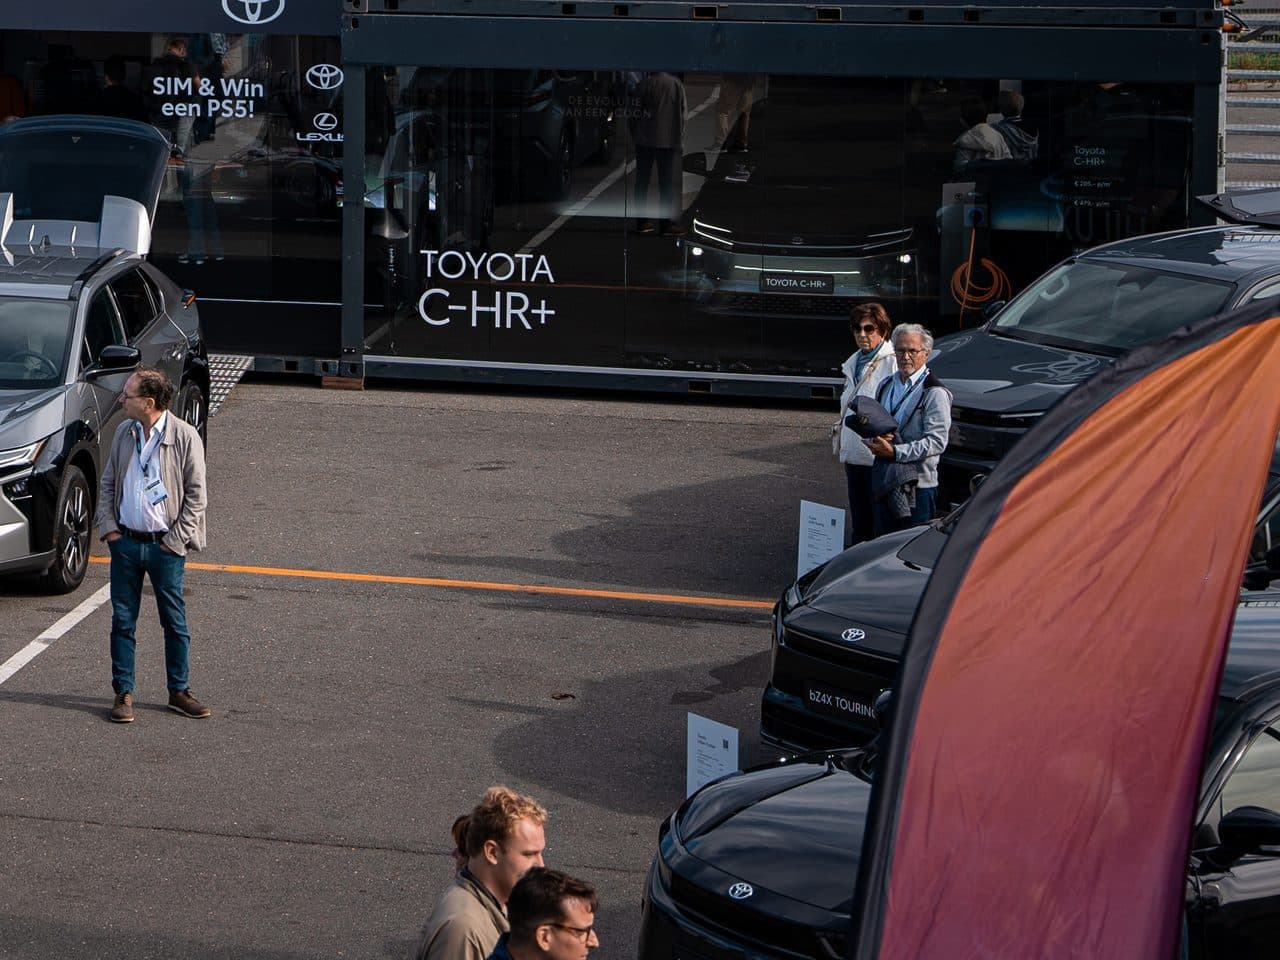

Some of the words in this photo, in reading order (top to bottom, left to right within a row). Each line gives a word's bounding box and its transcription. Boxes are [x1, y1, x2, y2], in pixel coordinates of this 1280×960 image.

[153, 77, 192, 96] SIM
[198, 77, 215, 96] &
[220, 78, 264, 98] Win
[162, 102, 200, 117] een
[207, 99, 254, 118] PS5!
[1074, 145, 1106, 156] Toyota
[1073, 157, 1105, 166] C-HR+
[419, 249, 555, 284] TOYOTA
[765, 278, 799, 288] TOYOTA
[799, 279, 827, 288] C-HR+
[418, 288, 556, 330] C-HR+
[809, 688, 833, 706] bZ4X
